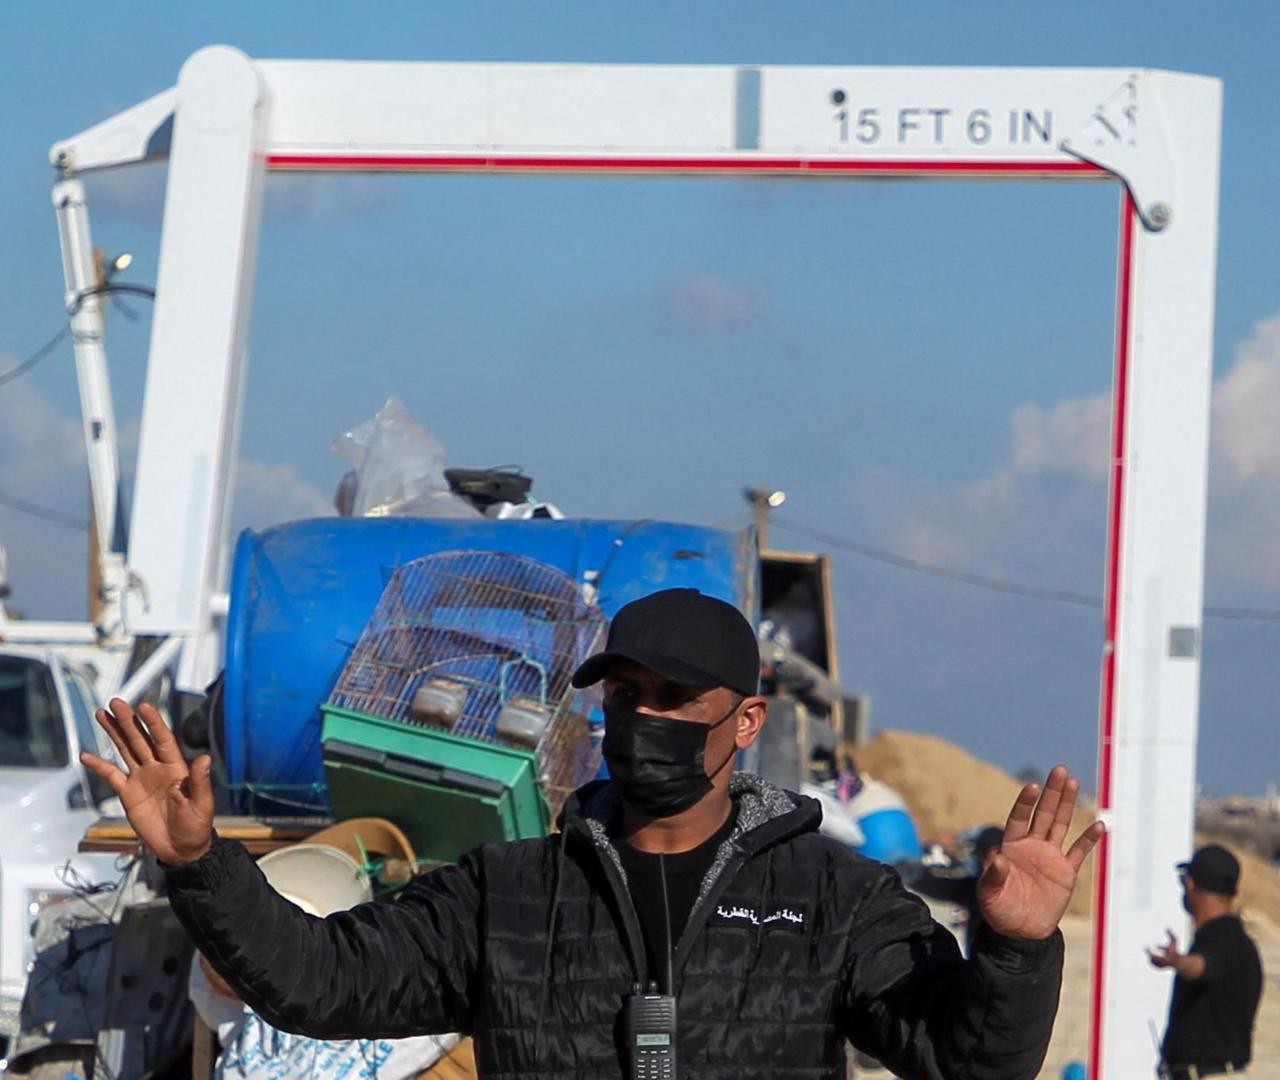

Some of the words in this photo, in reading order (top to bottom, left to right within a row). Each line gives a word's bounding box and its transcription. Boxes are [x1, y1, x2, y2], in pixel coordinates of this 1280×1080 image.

[833, 108, 881, 145] 15
[897, 108, 951, 143] FT
[966, 108, 992, 145] 6
[1009, 108, 1053, 143] IN
